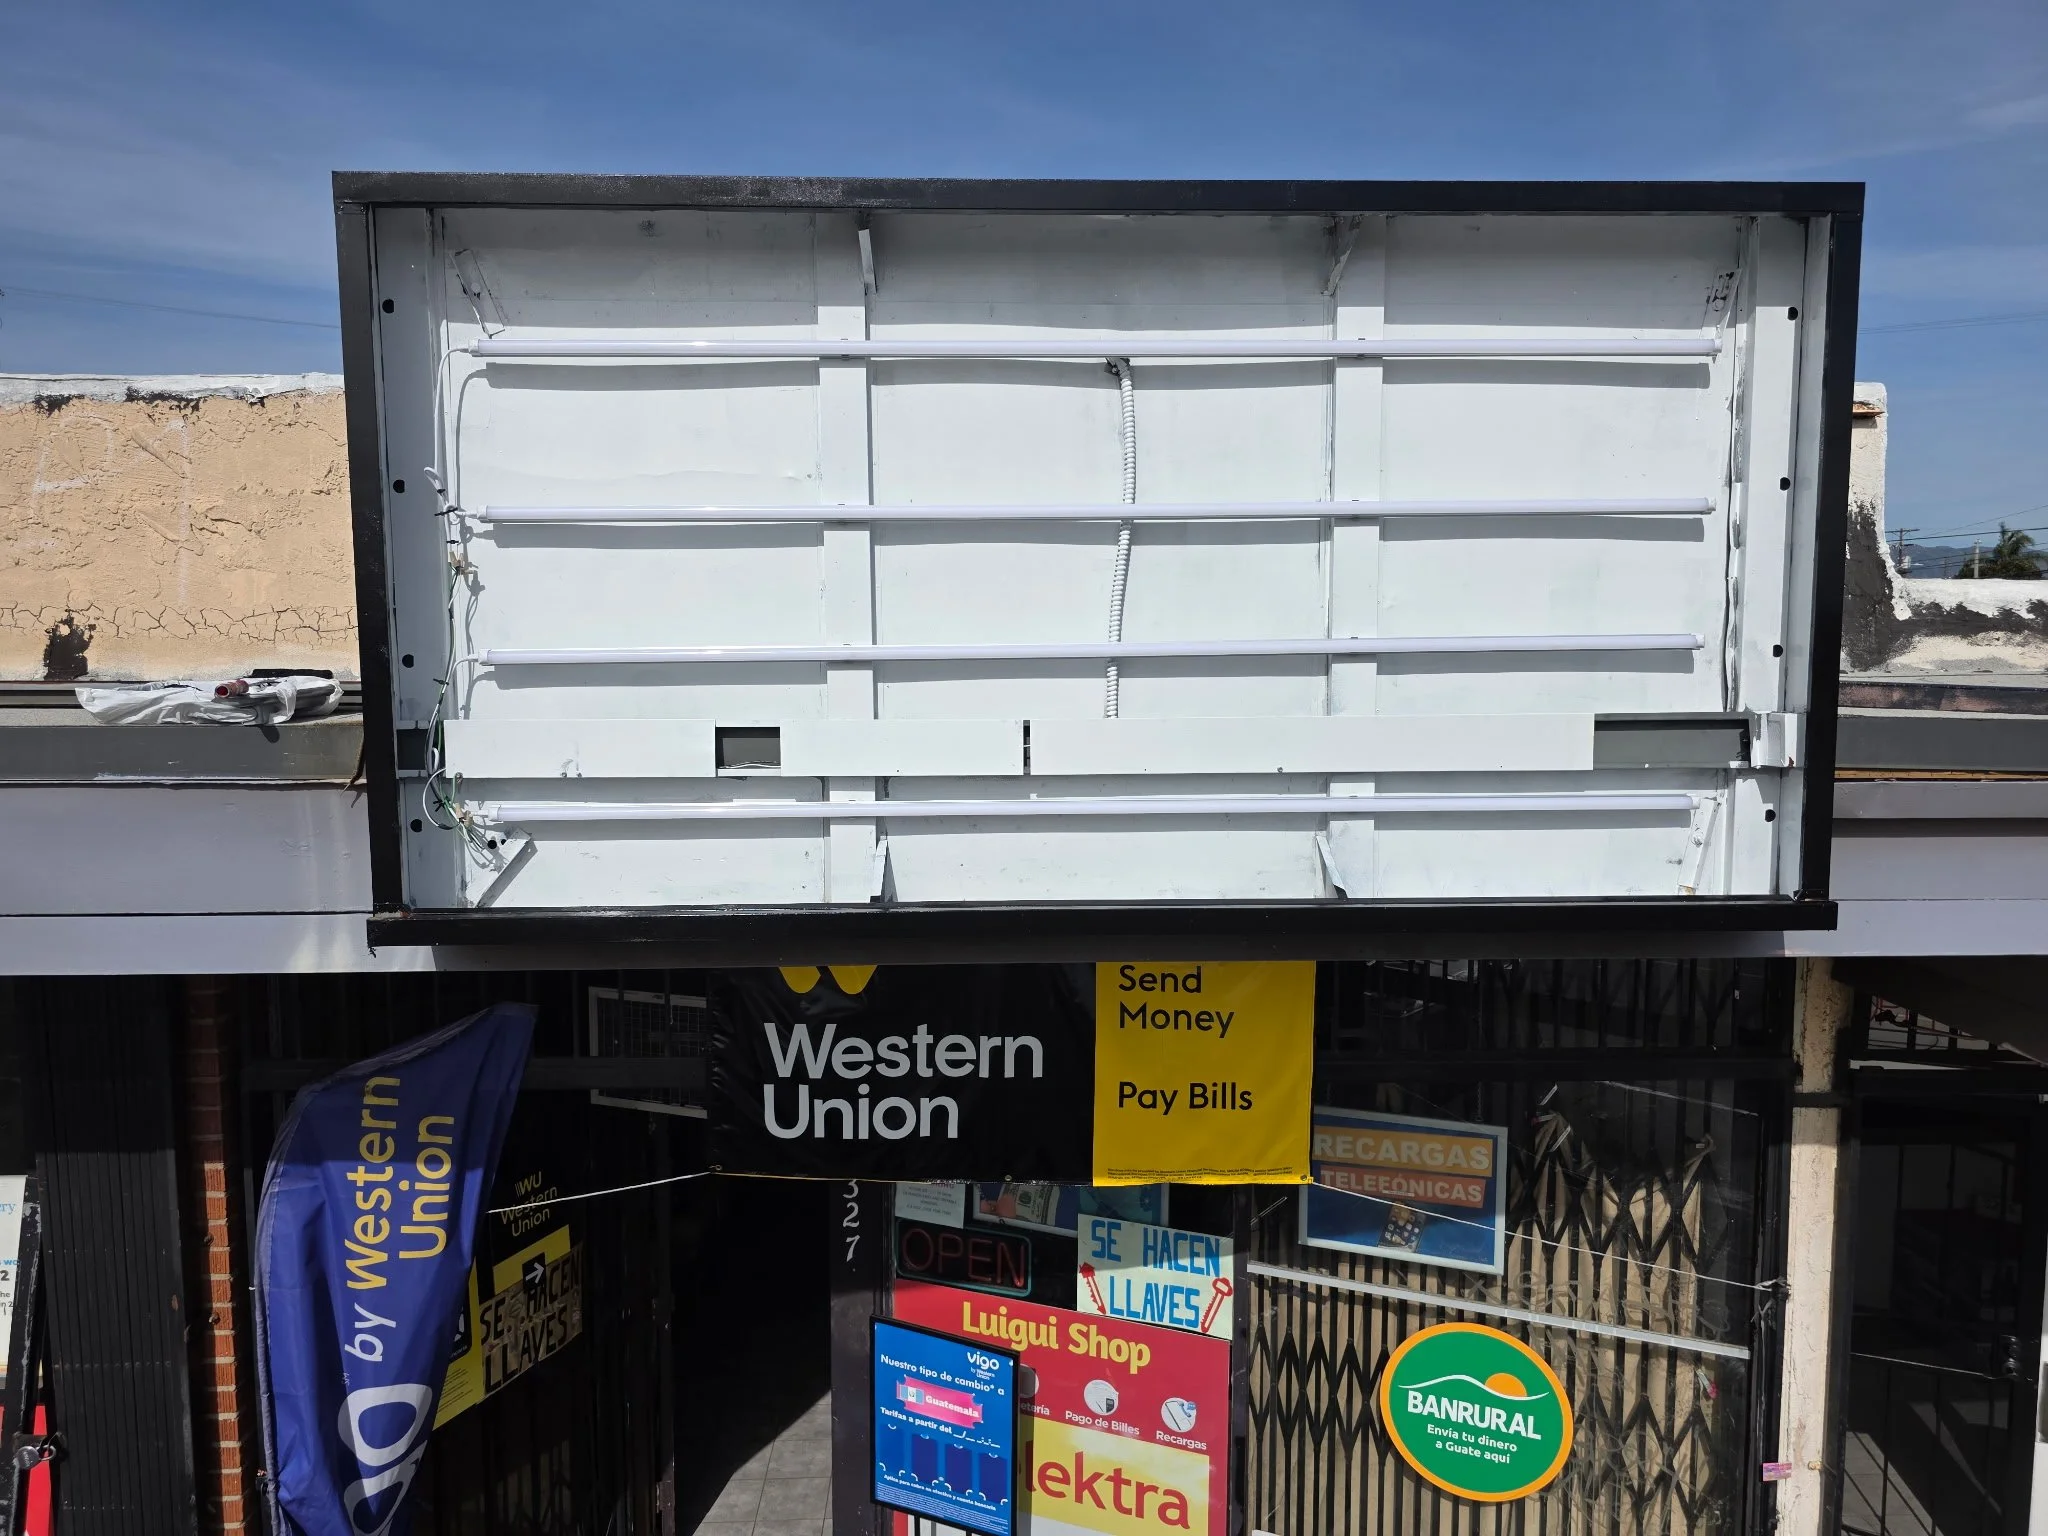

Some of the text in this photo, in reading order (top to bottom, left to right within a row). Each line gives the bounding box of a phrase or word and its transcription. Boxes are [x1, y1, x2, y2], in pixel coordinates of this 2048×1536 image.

[1118, 965, 1202, 993] Send
[1119, 1001, 1235, 1038] Money
[764, 1022, 1043, 1079] Western
[764, 1083, 959, 1140] Union
[1118, 1081, 1253, 1116] Pay Bills
[1313, 1133, 1490, 1170] RECARGAS
[344, 1076, 401, 1291] Western
[398, 1114, 455, 1260] Union
[500, 1186, 558, 1224] Western
[511, 1208, 550, 1237] Union
[902, 1228, 1026, 1287] OPEN
[1091, 1219, 1220, 1278] SE HACEN
[1110, 1275, 1200, 1329] LLAVES
[345, 1302, 397, 1363] by
[485, 1303, 568, 1395] LLAVES
[963, 1301, 1151, 1375] Luigui Shop
[880, 1354, 917, 1372] Nuestro
[920, 1365, 938, 1378] tipo
[940, 1371, 952, 1382] de
[997, 1388, 1005, 1396] a
[967, 1351, 999, 1370] vigo
[880, 1406, 952, 1434] Tarifas a partir del
[925, 1395, 980, 1418] Guatemala
[1065, 1410, 1092, 1426] Pago
[1095, 1417, 1109, 1429] de
[1111, 1421, 1140, 1436] Billes
[1407, 1390, 1542, 1440] BANRURAL
[1156, 1430, 1207, 1451] Recargas
[1427, 1423, 1518, 1452] Envía tu dinero
[1435, 1441, 1510, 1464] a Guate aquí
[1025, 1440, 1190, 1530] lektra
